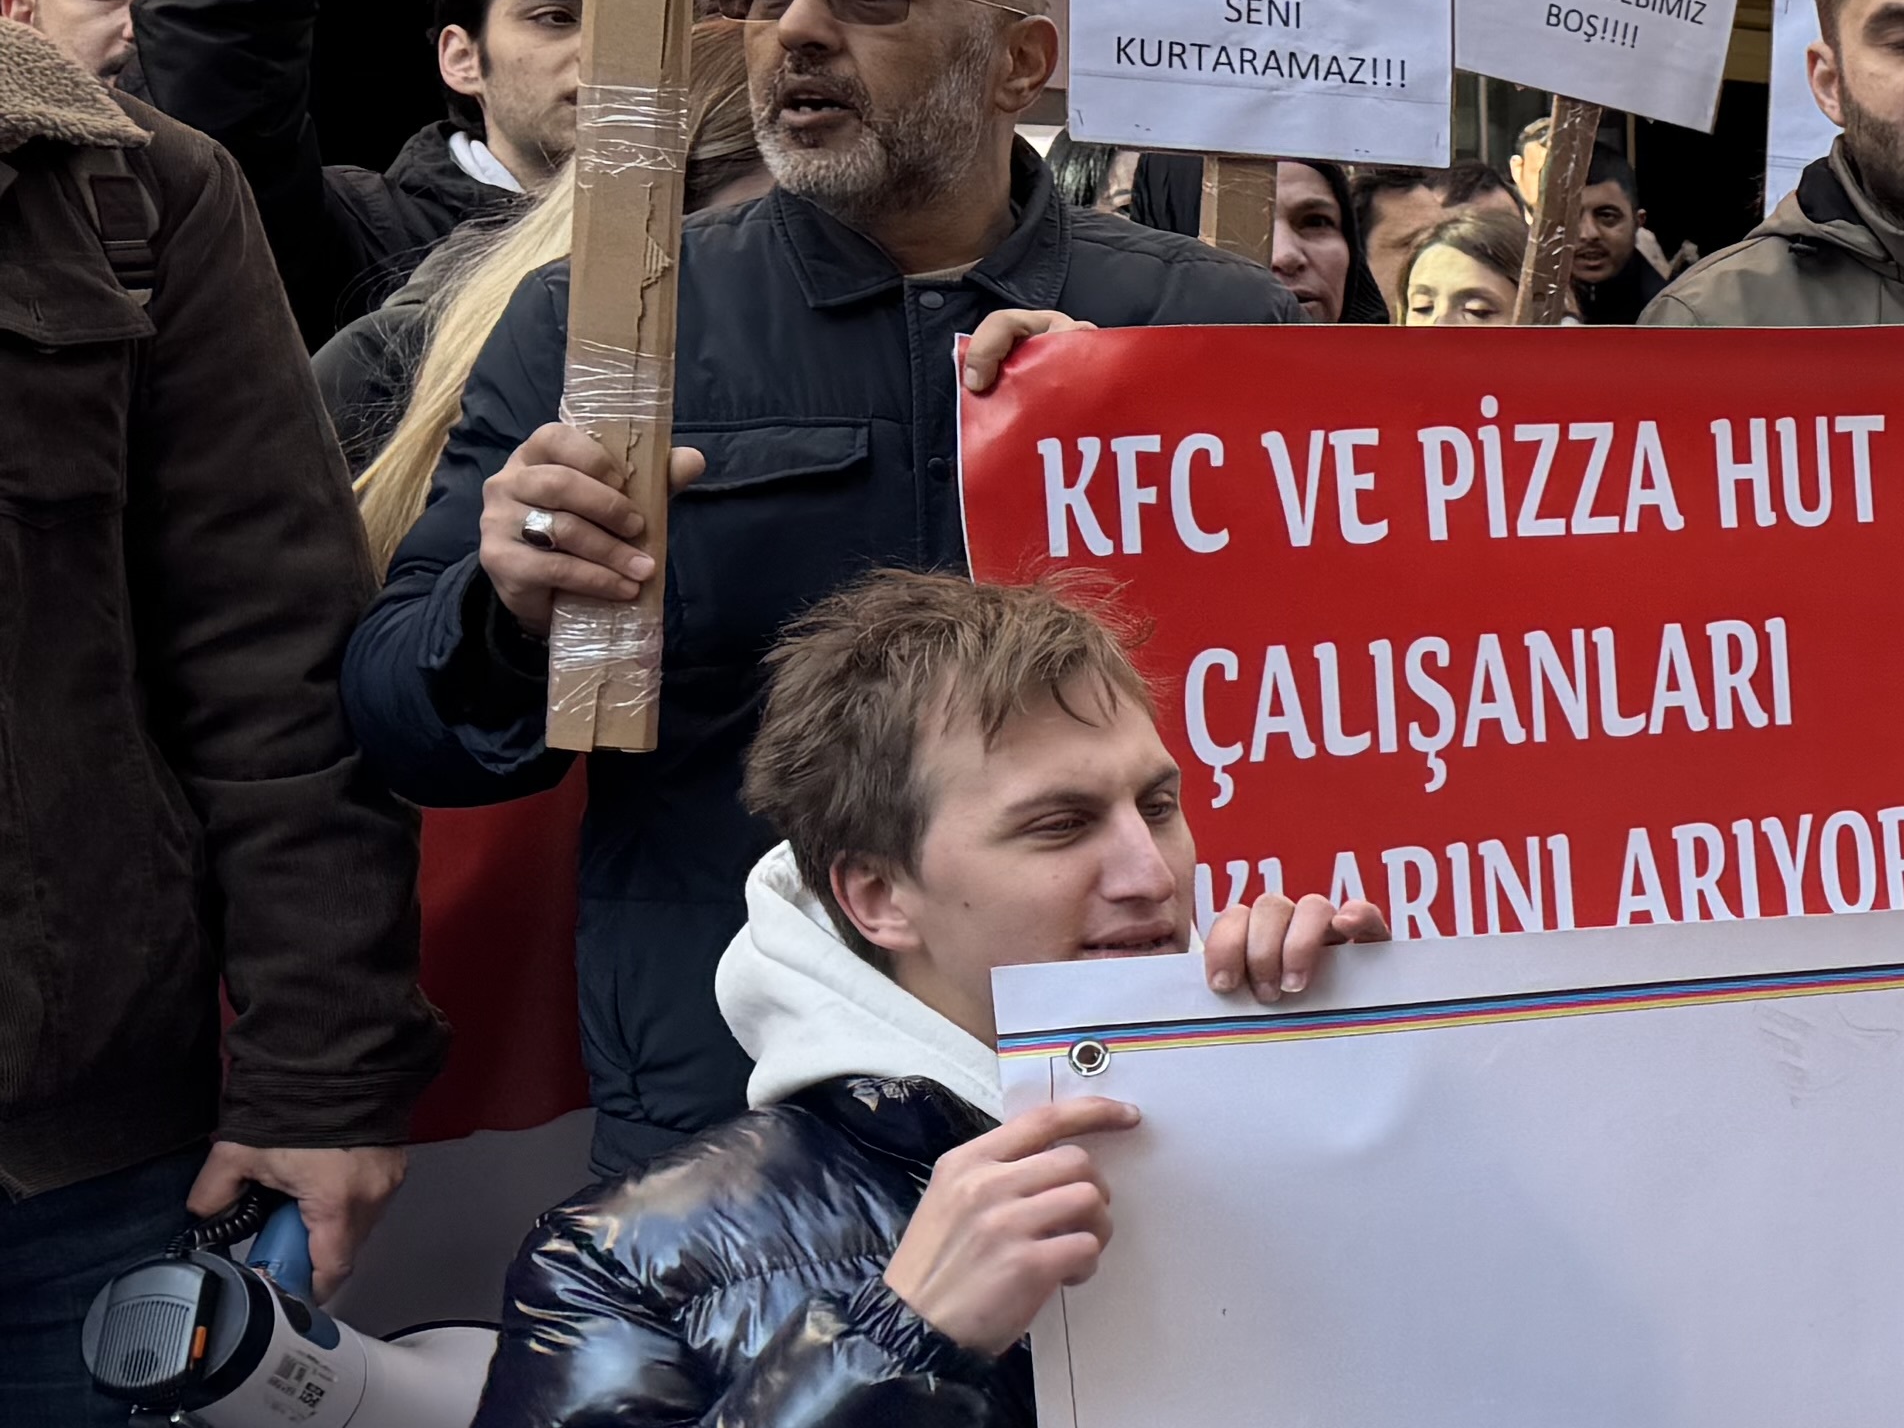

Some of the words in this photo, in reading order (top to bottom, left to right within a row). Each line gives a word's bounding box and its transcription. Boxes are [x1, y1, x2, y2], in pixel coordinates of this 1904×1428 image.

[1115, 36, 1408, 90] KURTARAMAZ!!!
[1545, 2, 1640, 50] BOŞ!!!!
[1037, 431, 1230, 558] KFC
[1261, 427, 1389, 548] VE
[1416, 393, 1685, 542] PİZZA
[1710, 415, 1886, 532] HUT
[1184, 617, 1795, 808] ÇALIŞANLARI
